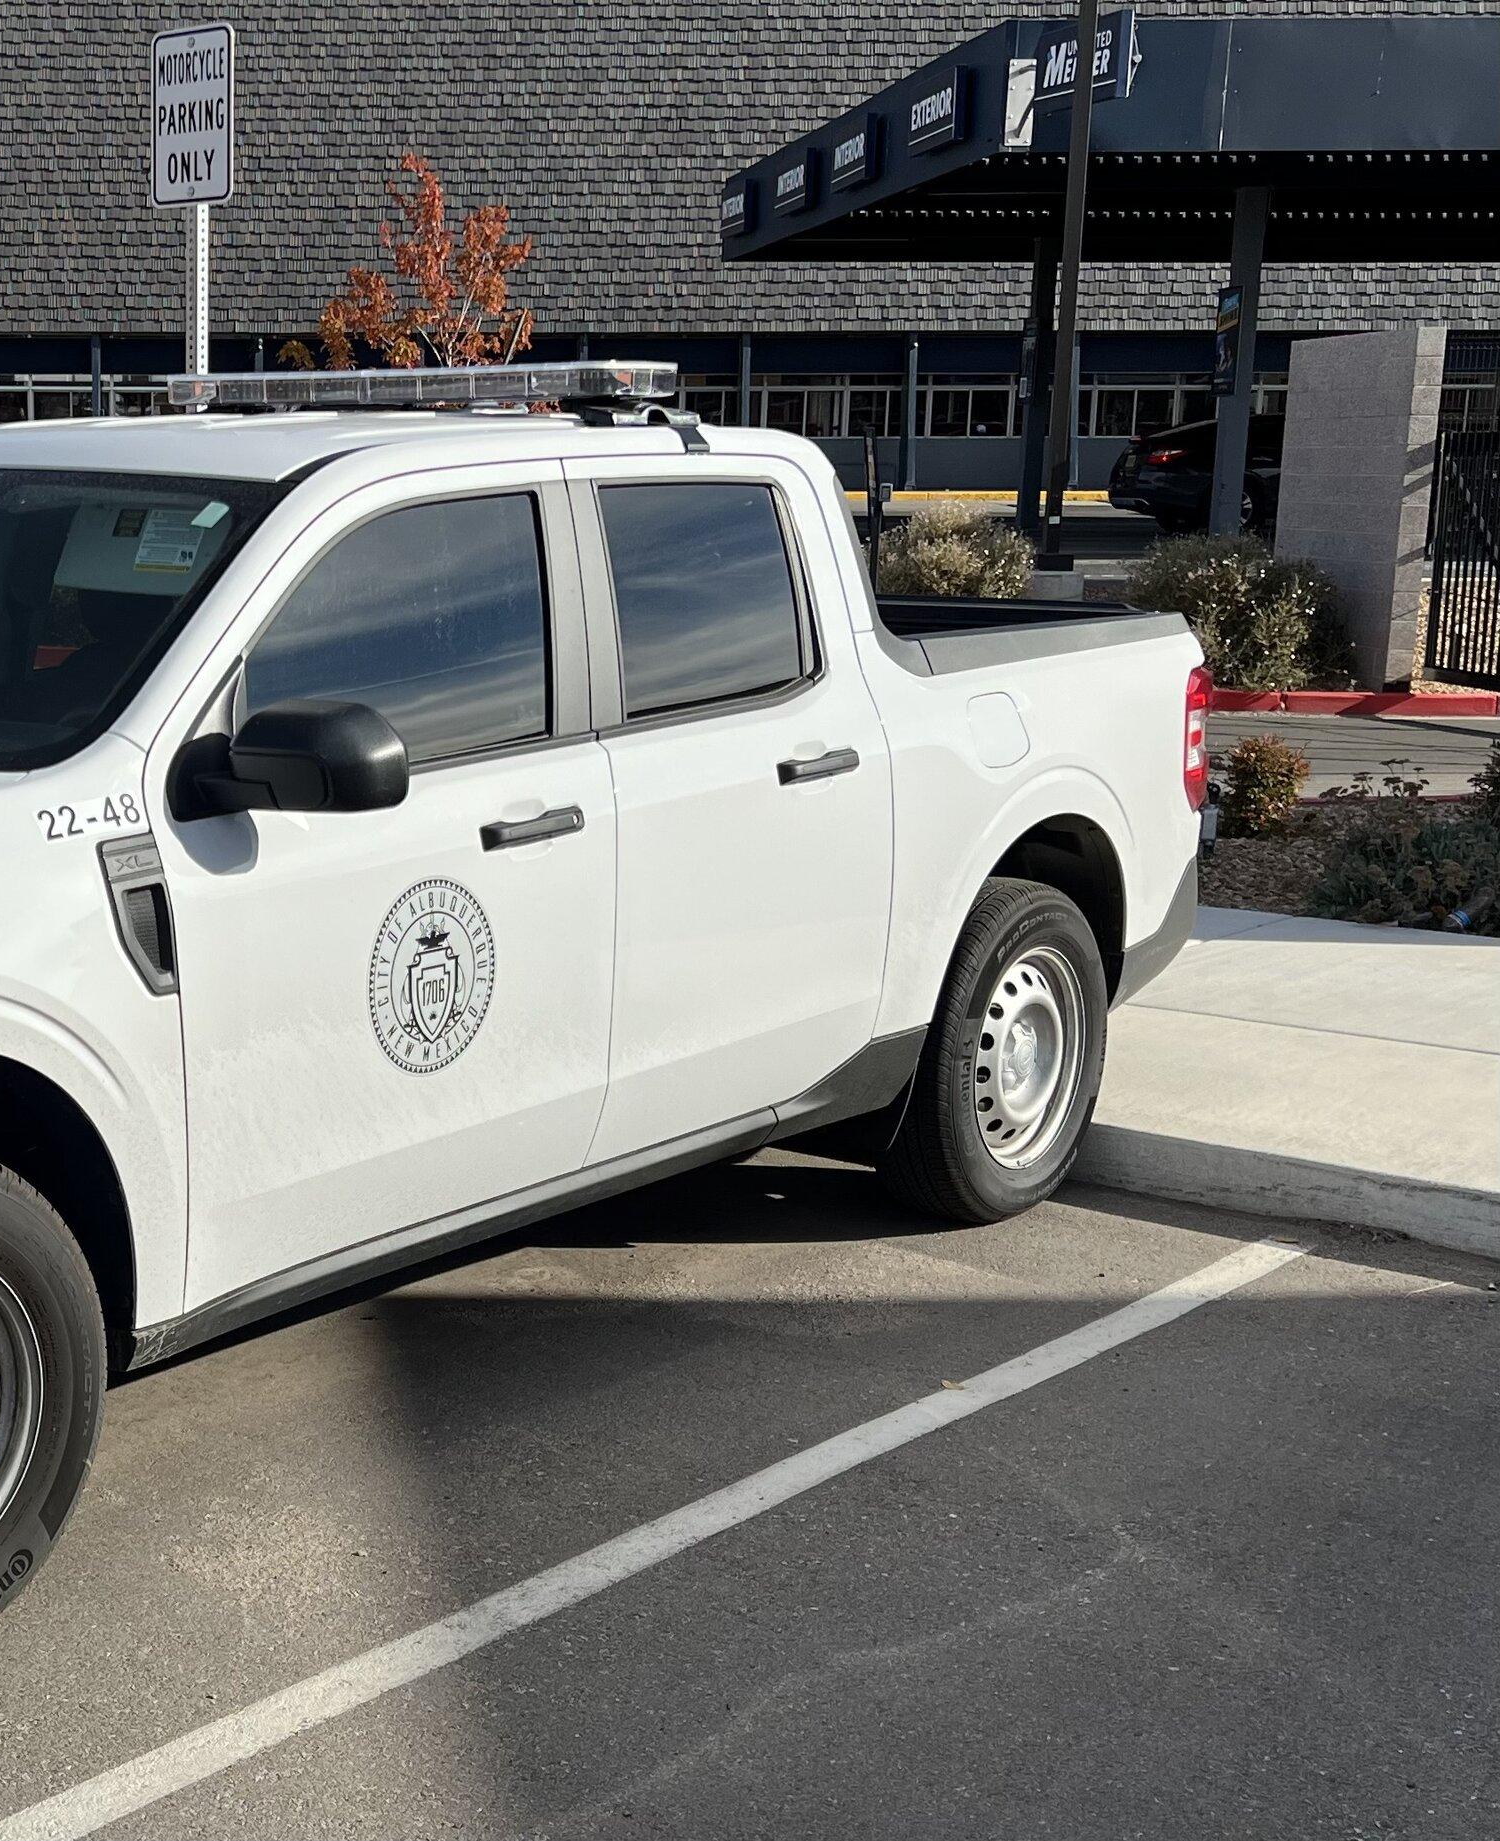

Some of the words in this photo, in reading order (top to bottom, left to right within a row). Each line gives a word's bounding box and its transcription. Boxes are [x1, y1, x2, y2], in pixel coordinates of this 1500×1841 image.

[158, 47, 225, 87] MOTORCYCLE
[158, 98, 225, 136] PARKING
[910, 87, 952, 132] EXTERIOR
[167, 149, 215, 184] ONLY
[833, 132, 865, 171] INTERIOR
[776, 163, 805, 198] INTERIOR
[37, 793, 141, 841] 22-48
[115, 855, 154, 872] XL
[377, 955, 391, 1008] CITY
[386, 920, 405, 945] OF
[408, 891, 489, 985] ALBUQUERQUE
[421, 976, 445, 1007] 1706
[385, 1024, 416, 1059] NEW
[421, 1005, 479, 1062] MEXICO
